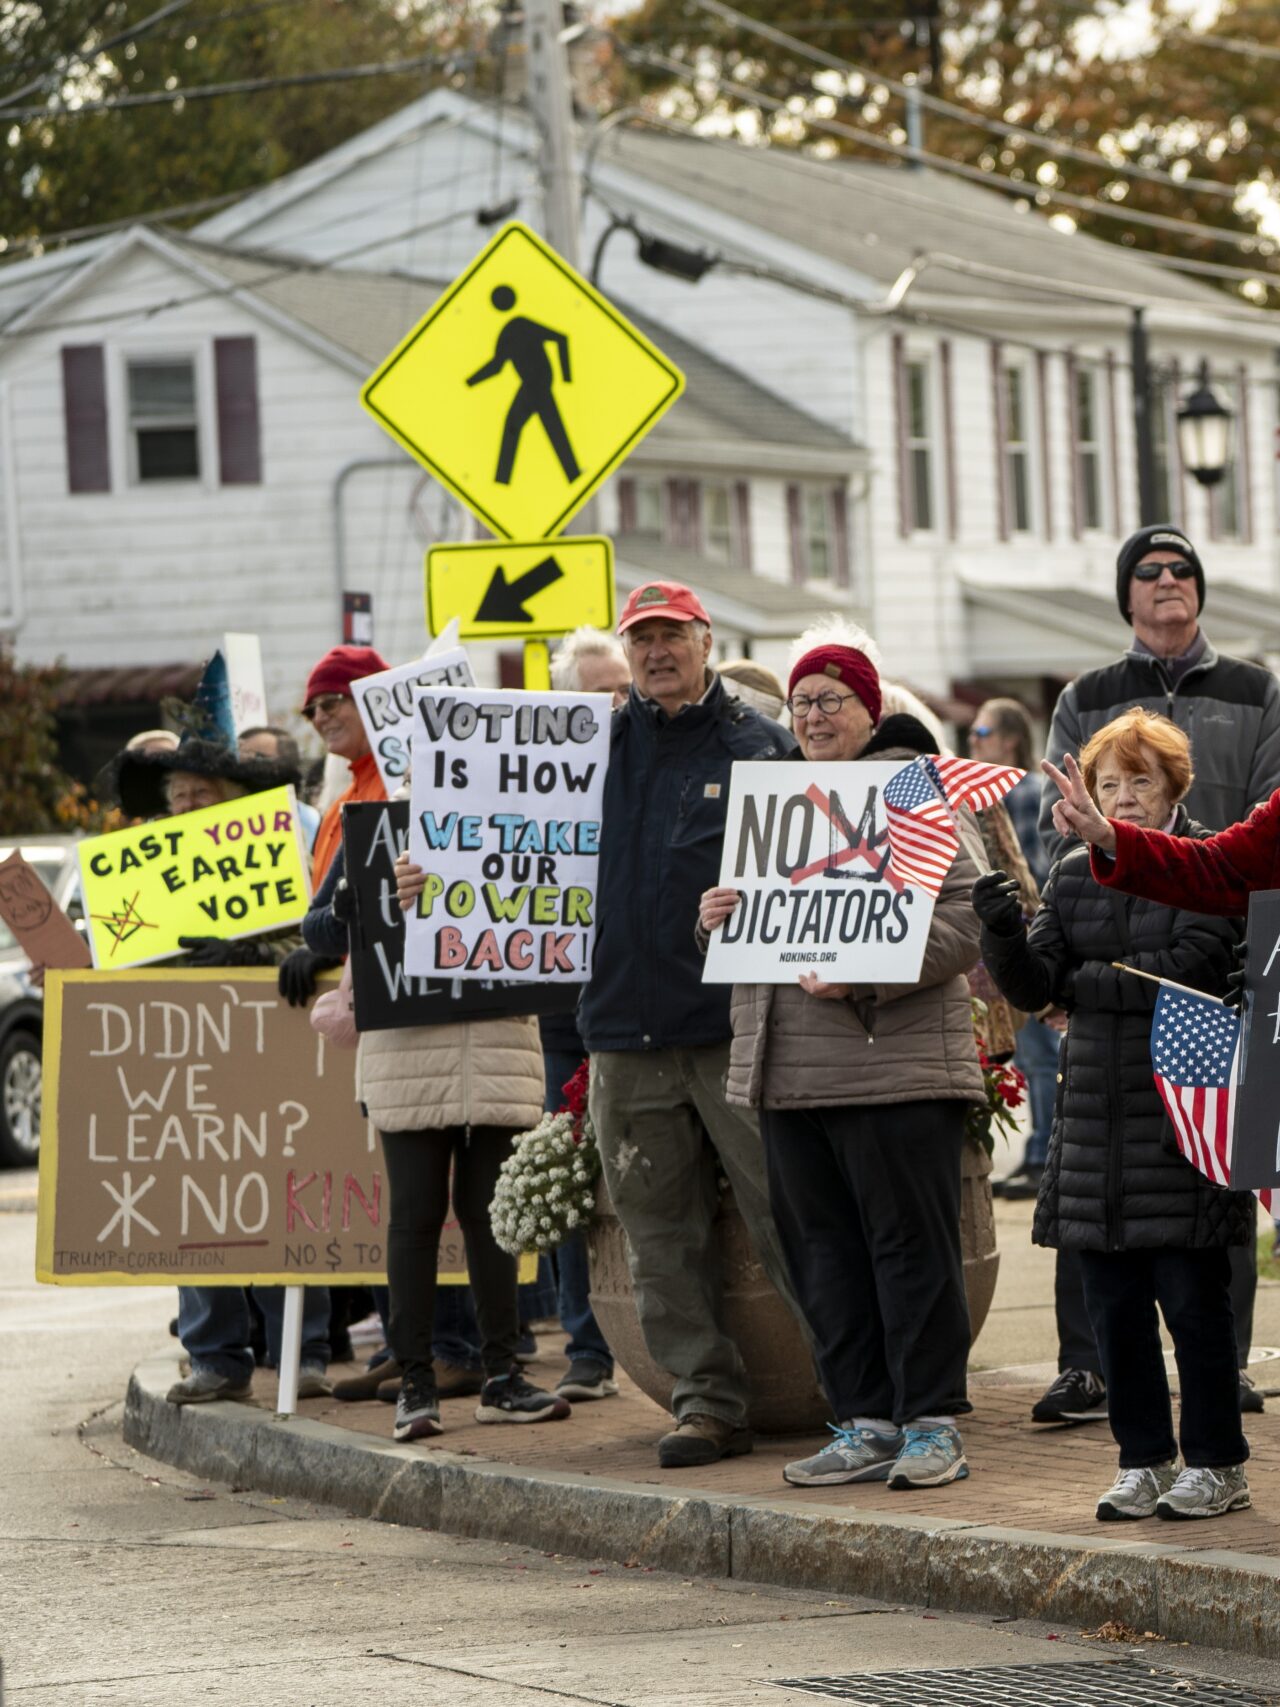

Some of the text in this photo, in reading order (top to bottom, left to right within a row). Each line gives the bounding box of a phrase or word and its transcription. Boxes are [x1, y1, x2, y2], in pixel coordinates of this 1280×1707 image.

[419, 696, 599, 745] VOTING
[499, 753, 598, 795] HOW
[90, 811, 292, 877] CAST YOUR
[420, 810, 601, 855] WE TAKE
[734, 793, 815, 879] NO
[160, 842, 286, 894] EARLY
[482, 852, 558, 885] OUR
[197, 877, 298, 923] VOTE
[416, 873, 594, 927] POWER
[720, 888, 914, 945] DICTATORS
[434, 925, 590, 974] BACK!
[779, 952, 838, 963] NOKINGS.ORG
[86, 984, 279, 1059] DIDN'T
[117, 1064, 217, 1112] WE
[88, 1100, 310, 1162] LEARN?
[180, 1169, 383, 1236] NO KIN
[56, 1249, 226, 1269] TRUMP=CORRUPTION
[284, 1242, 318, 1267] NO
[325, 1236, 343, 1272] $
[353, 1242, 383, 1265] TO
